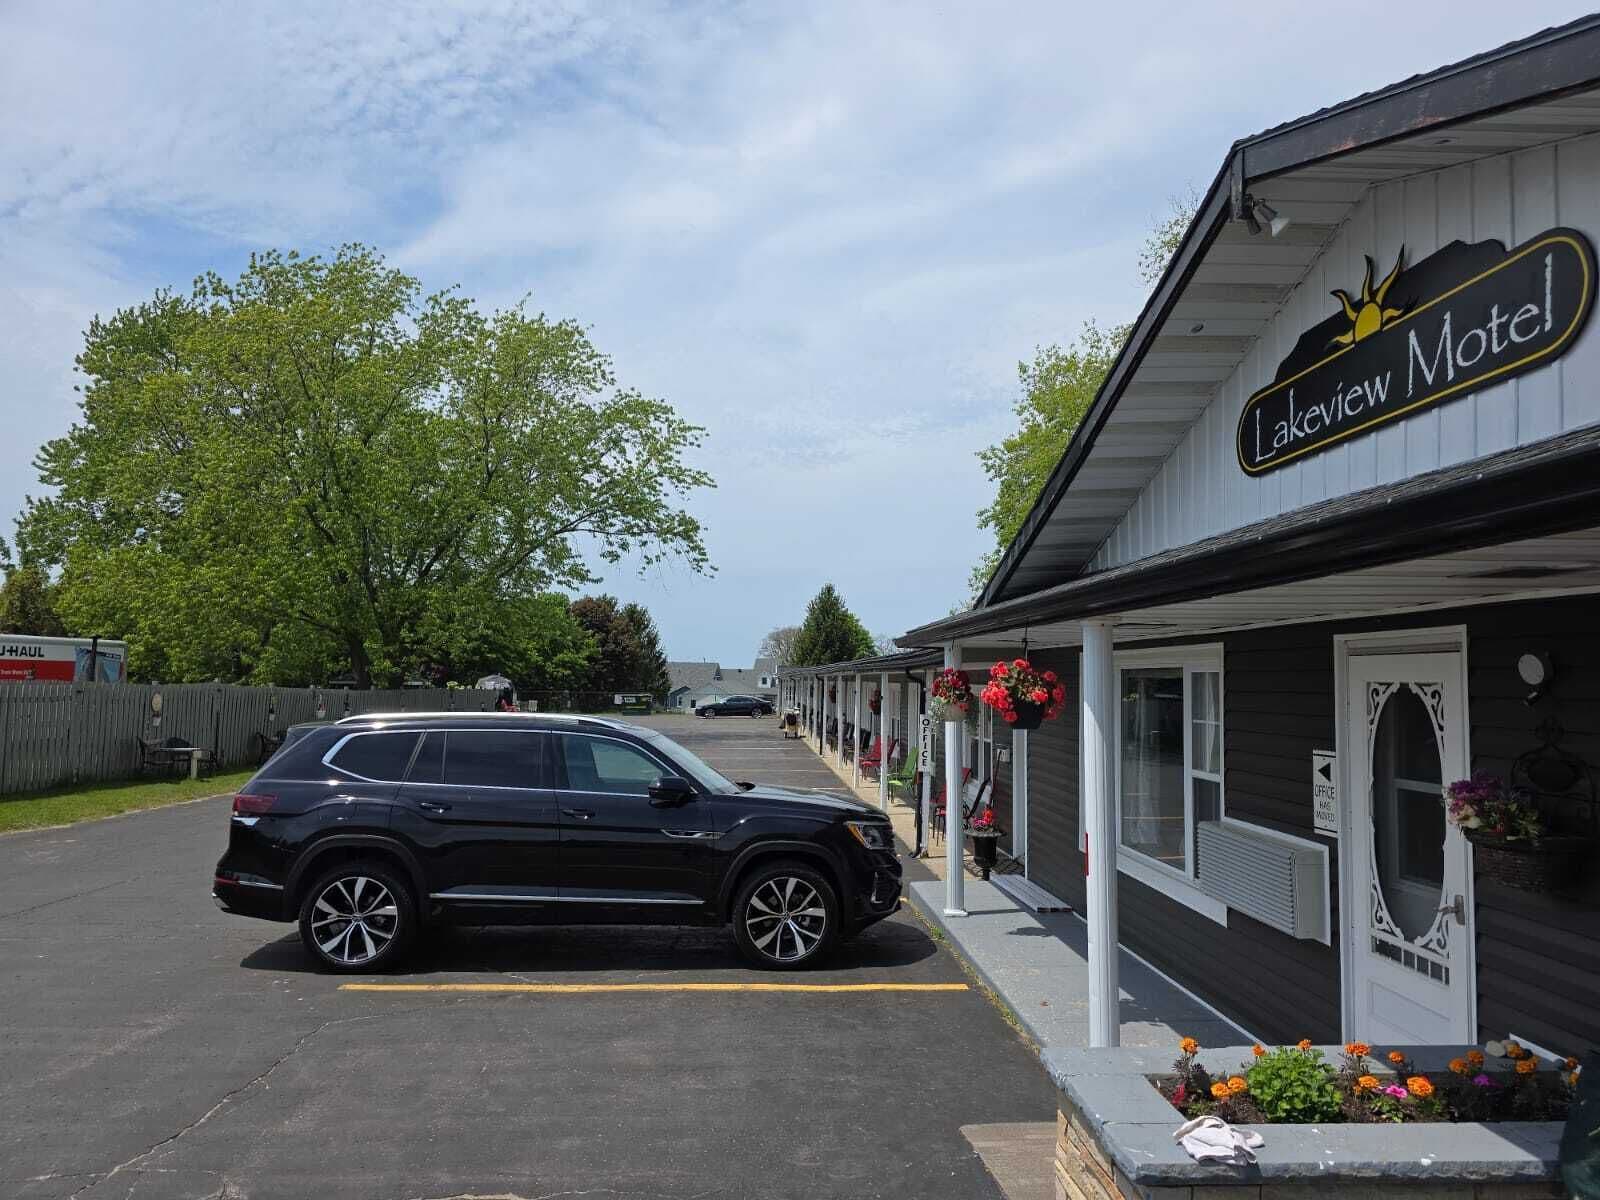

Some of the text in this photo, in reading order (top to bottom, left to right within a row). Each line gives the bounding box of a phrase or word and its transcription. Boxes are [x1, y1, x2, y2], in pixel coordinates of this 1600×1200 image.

[1255, 252, 1552, 463] Lakeview Motel
[921, 718, 930, 767] OFFICE
[1314, 783, 1335, 801] OFFICE
